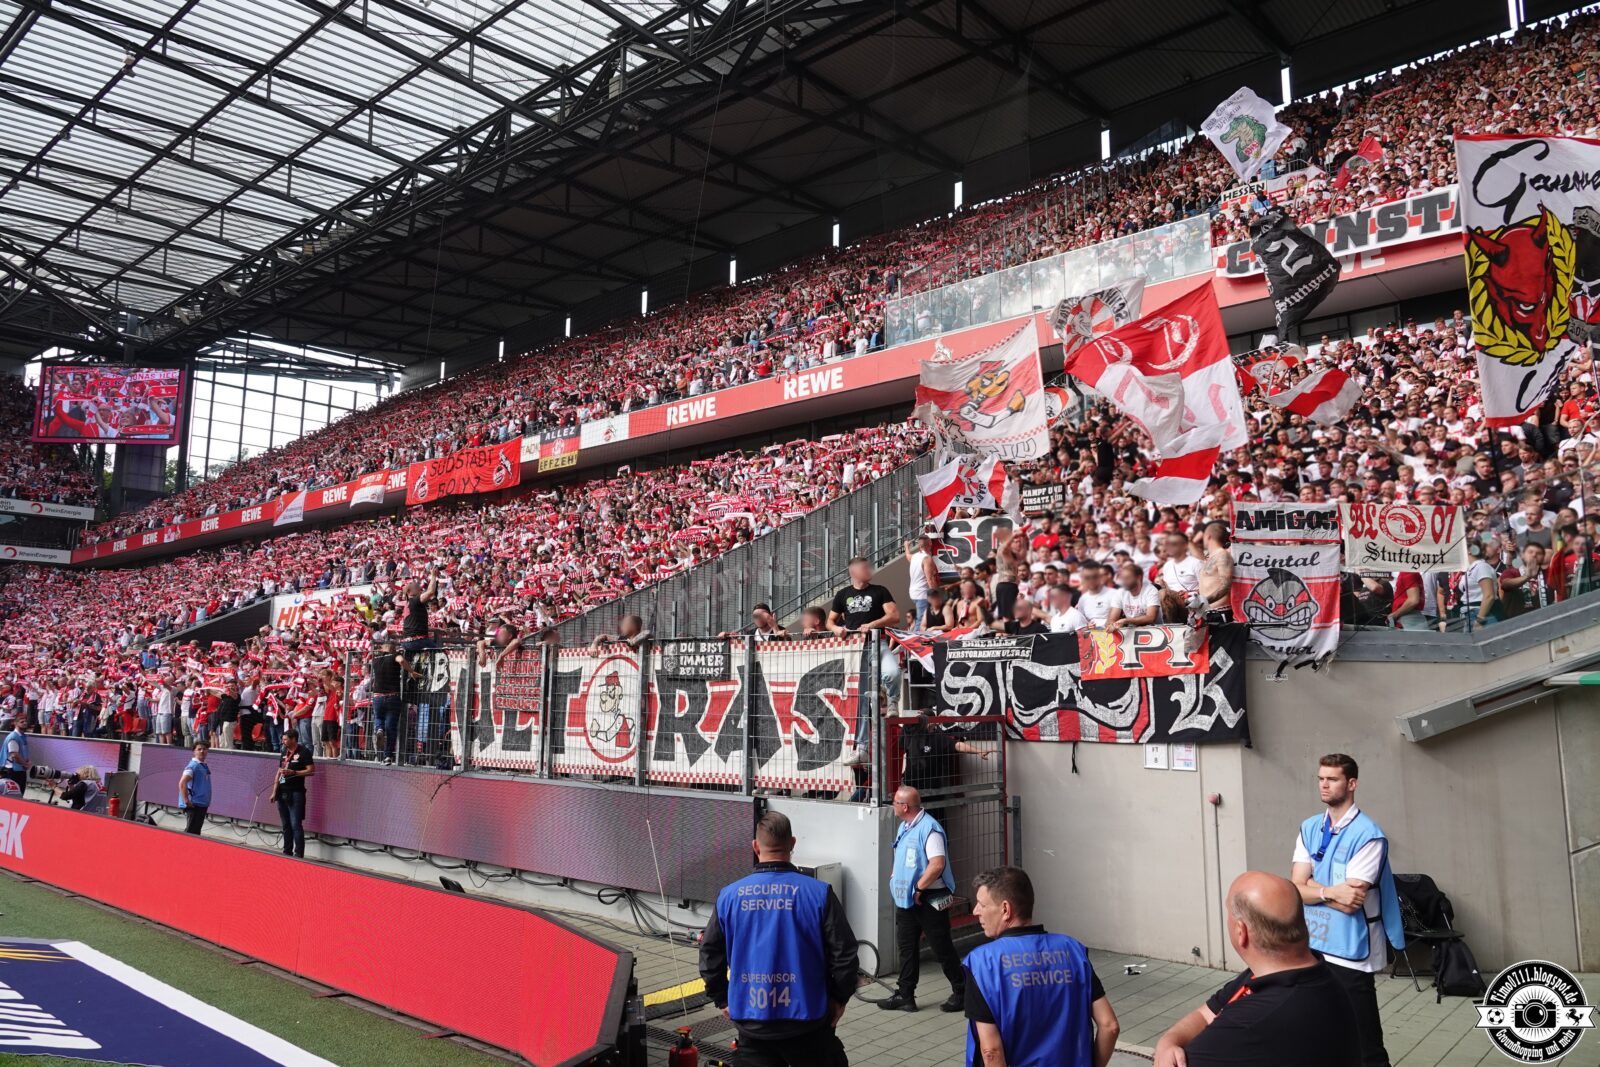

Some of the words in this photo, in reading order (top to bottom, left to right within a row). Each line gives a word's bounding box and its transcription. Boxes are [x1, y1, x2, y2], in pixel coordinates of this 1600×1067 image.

[1222, 182, 1266, 199] HESSEN
[1265, 236, 1314, 278] 2
[783, 366, 844, 400] REWE
[666, 397, 716, 426] REWE
[545, 426, 576, 441] ALLEZ
[322, 486, 348, 505] REWE
[241, 506, 262, 523] REWE
[200, 517, 219, 532] REWE
[1431, 504, 1458, 545] 07
[112, 539, 128, 552] REWE
[142, 531, 158, 546] REWE
[1233, 551, 1321, 569] Leintal
[1361, 541, 1445, 570] Stuttgart
[276, 606, 304, 628] HI
[680, 642, 696, 653] DU
[700, 642, 725, 654] BIST
[1001, 649, 1031, 658] ULTRAS
[680, 655, 725, 667] IMMER
[680, 666, 696, 676] BEI
[700, 667, 725, 677] UNS!
[738, 884, 799, 896] SECURITY
[741, 899, 793, 911] SERVICE
[1308, 920, 1330, 943] 22
[1002, 951, 1071, 969] SECURITY
[741, 973, 796, 983] SUPERVISOR
[1011, 969, 1072, 988] SERVICE
